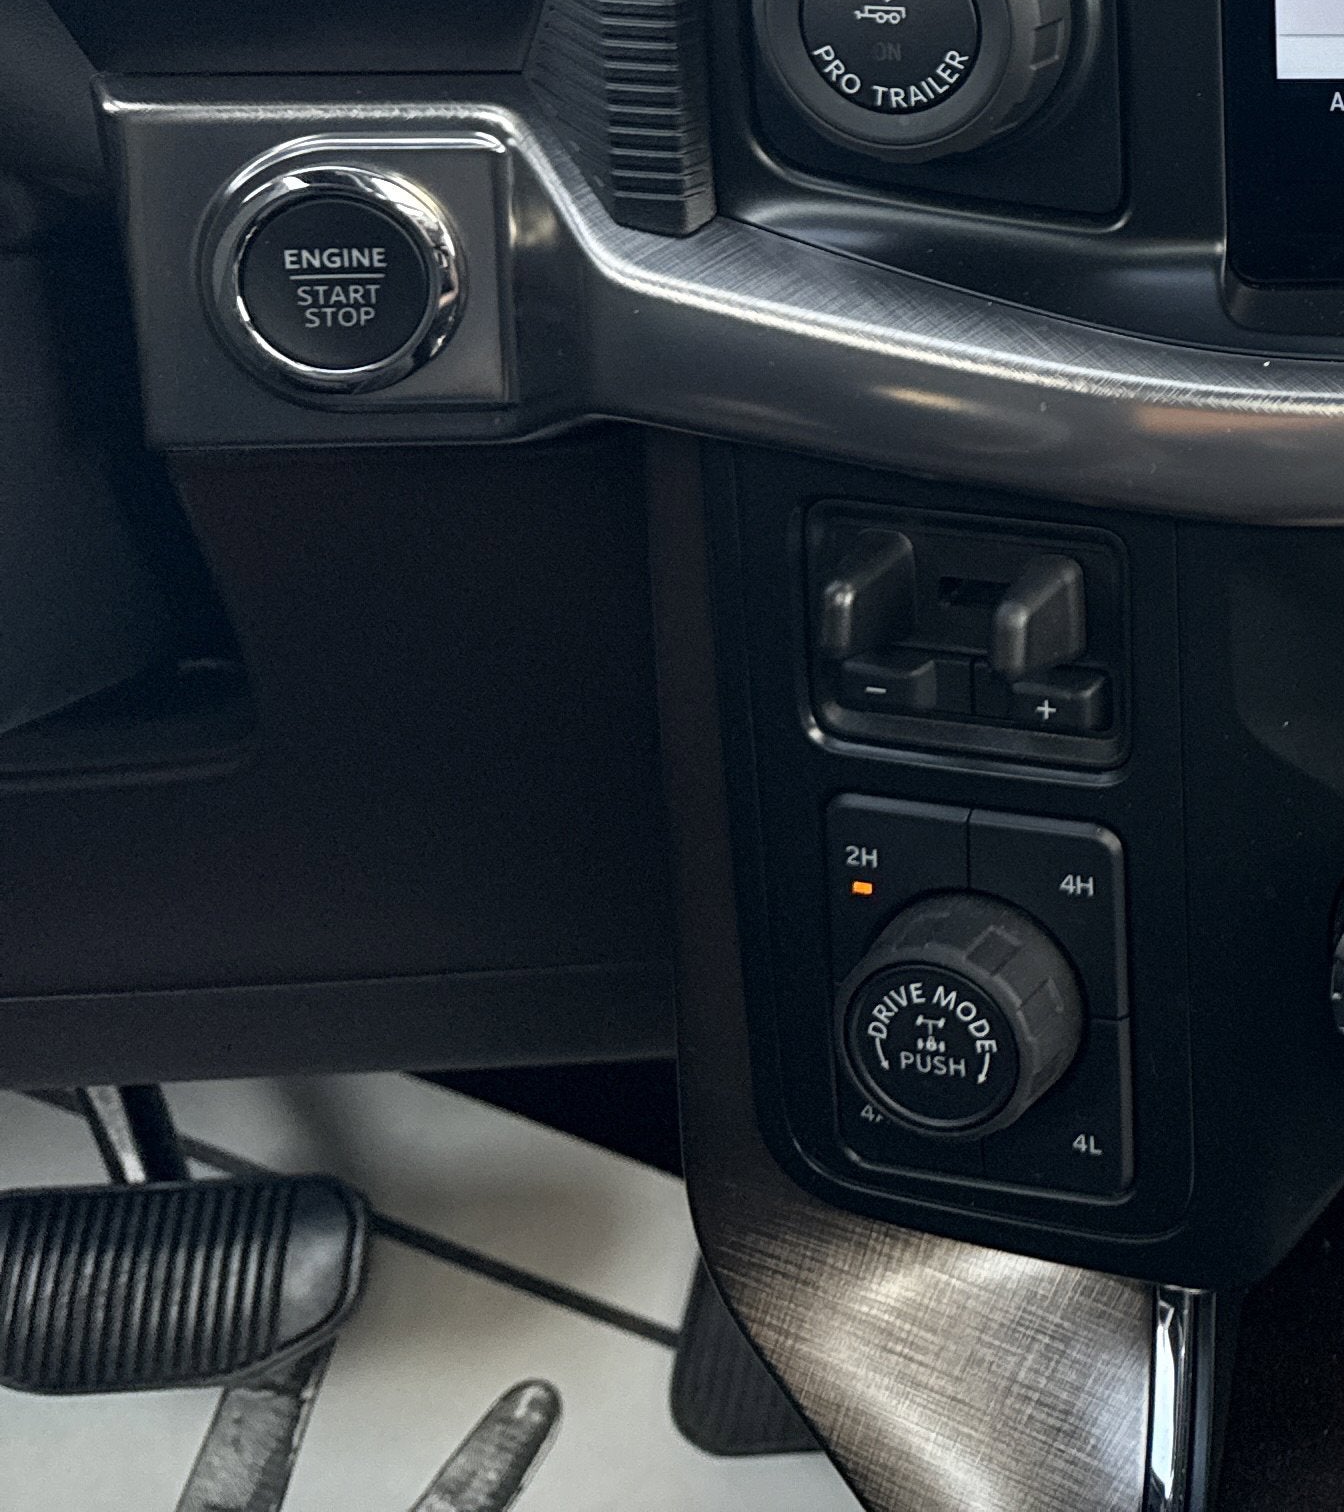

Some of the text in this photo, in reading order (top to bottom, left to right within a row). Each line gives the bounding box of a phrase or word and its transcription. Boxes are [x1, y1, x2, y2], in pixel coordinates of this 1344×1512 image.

[812, 44, 970, 109] PRO TRAILER
[283, 246, 388, 270] ENGINE
[296, 284, 381, 307] START
[304, 307, 376, 328] STOP
[845, 845, 878, 869] 2H
[1060, 873, 1095, 897] 4H
[867, 982, 998, 1054] DRIVE MODE
[900, 1051, 966, 1078] PUSH
[1072, 1133, 1103, 1156] 4L
